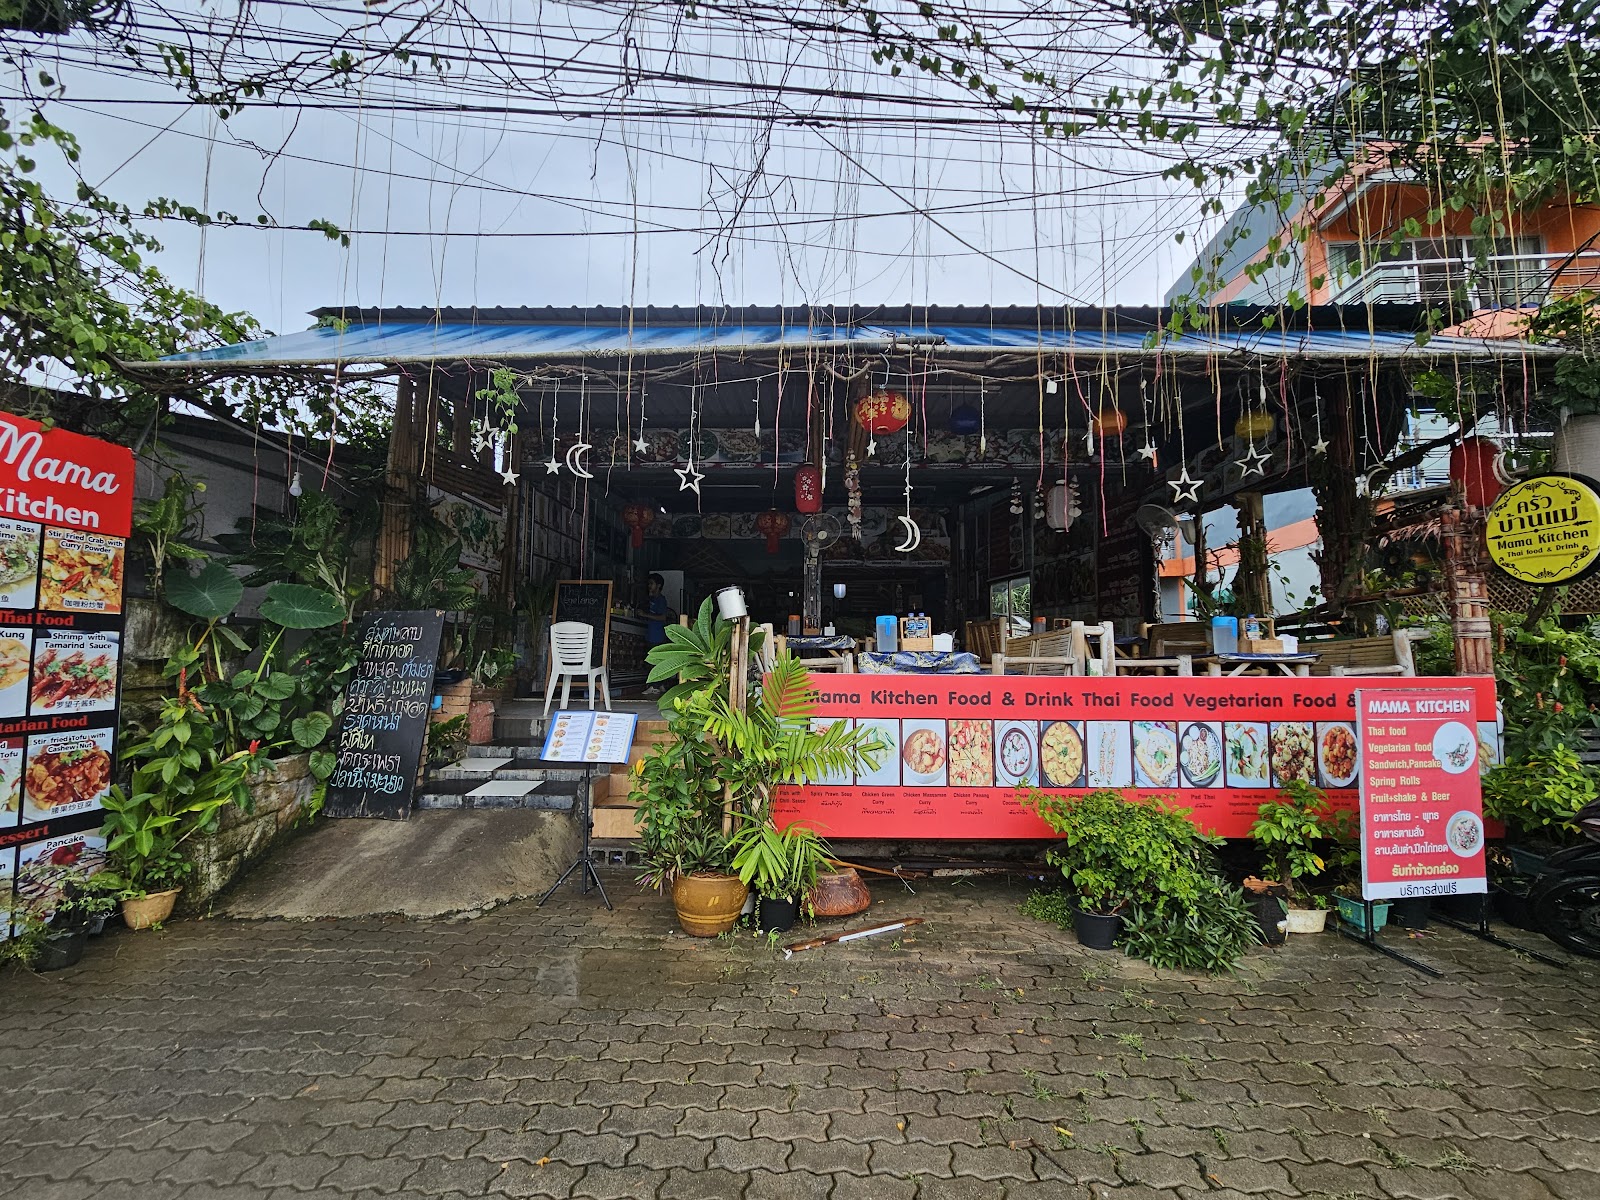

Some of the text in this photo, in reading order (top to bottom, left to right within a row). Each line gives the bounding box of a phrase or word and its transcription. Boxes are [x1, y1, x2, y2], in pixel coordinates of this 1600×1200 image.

[0, 420, 120, 495] Mama
[1517, 494, 1552, 514] ครัว
[1498, 501, 1578, 533] บ้านแม่
[16, 524, 35, 533] Bass
[66, 532, 84, 541] Fried
[88, 536, 104, 544] Crab
[1497, 529, 1588, 550] Mama Kitchen
[61, 541, 111, 553] Curry Powder
[1556, 543, 1579, 551] Drink
[35, 612, 74, 626] Food
[52, 632, 83, 641] Shrimp
[44, 641, 84, 649] Tamarind
[871, 689, 938, 706] Kitchen
[948, 691, 991, 706] Food
[1001, 692, 1015, 706] &
[1025, 692, 1073, 707] Drink
[1082, 692, 1120, 707] Thai
[1131, 693, 1174, 707] Food
[1183, 693, 1283, 711] Vegetarian
[1293, 694, 1336, 707] Food
[1368, 699, 1470, 713] MAMA KITCHEN
[52, 715, 88, 728] Food
[1368, 726, 1407, 736] Thai food
[48, 744, 76, 752] Cashew
[1368, 743, 1432, 754] Vegetarian food
[0, 750, 18, 759] Tofu
[1369, 759, 1441, 770] Sandwich,Pancake
[1370, 775, 1420, 787] Spring Rolls
[1370, 793, 1417, 803] Fruit+shake
[1421, 792, 1428, 801] &
[1432, 792, 1450, 801] Beer
[1373, 809, 1411, 822] อาหารไทย
[1374, 824, 1425, 838] อาหารตามสั่ง
[46, 834, 85, 849] Pancake
[1391, 861, 1460, 877] รับทำข้าวกล่อง
[1399, 881, 1457, 897] บริการส่งฟรี
